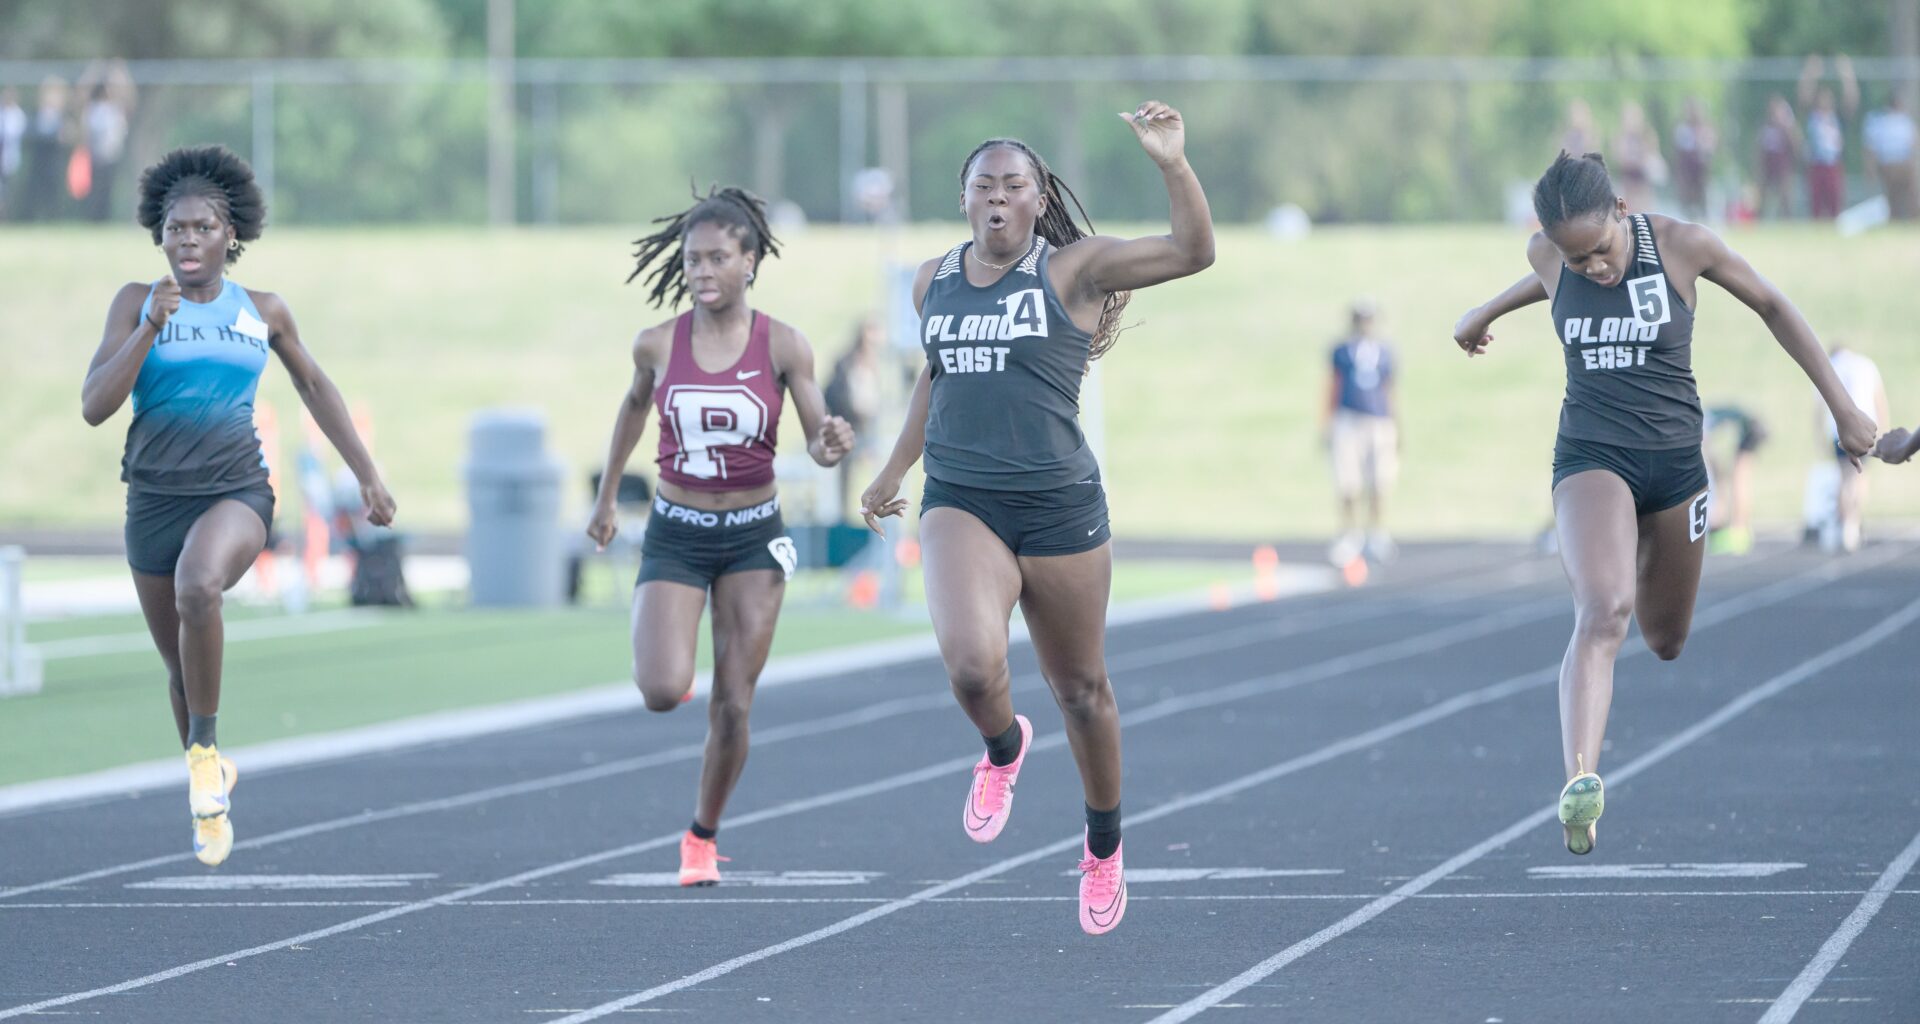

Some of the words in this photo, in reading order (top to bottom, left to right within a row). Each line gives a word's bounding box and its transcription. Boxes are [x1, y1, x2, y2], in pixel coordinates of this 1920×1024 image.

[1013, 292, 1042, 333] 4
[1634, 279, 1664, 323] 5
[925, 314, 1013, 344] PLANO
[939, 347, 1010, 374] EAST
[1581, 346, 1653, 370] EAST
[664, 384, 768, 480] P
[667, 505, 719, 528] PRO
[724, 500, 775, 528] NIKE
[1694, 493, 1708, 535] 5
